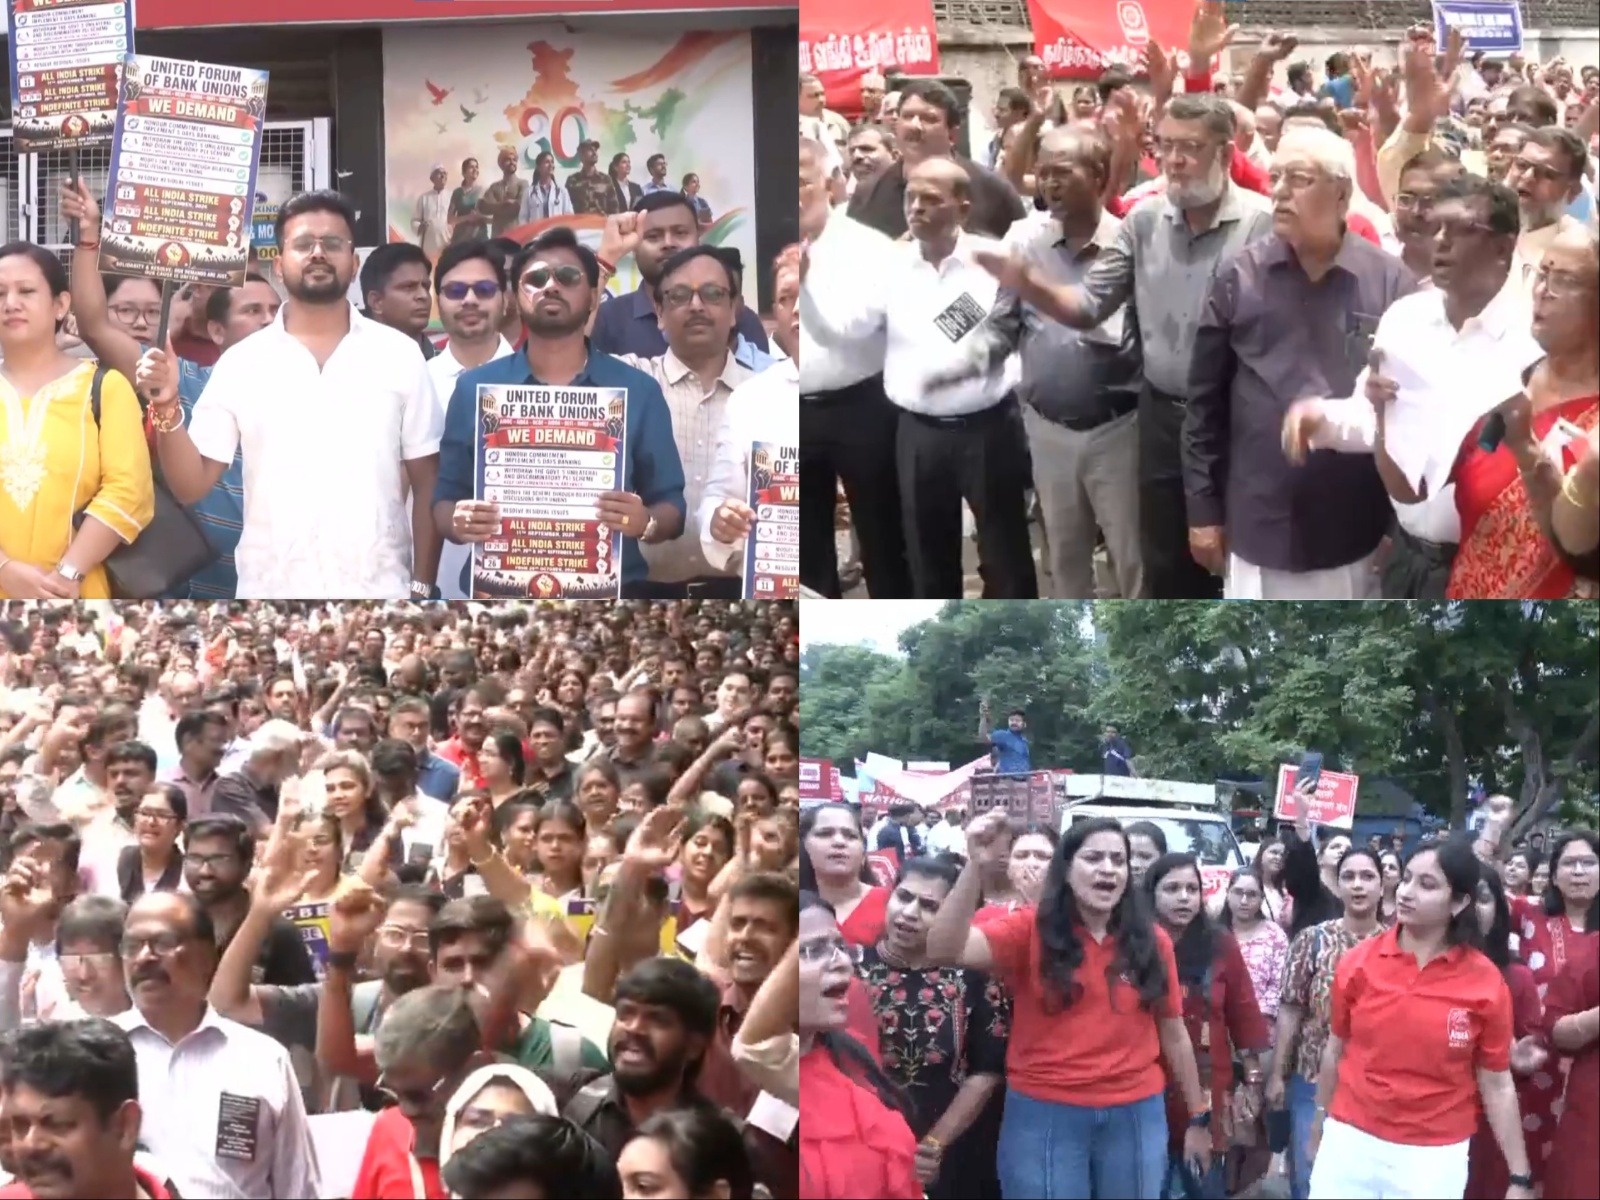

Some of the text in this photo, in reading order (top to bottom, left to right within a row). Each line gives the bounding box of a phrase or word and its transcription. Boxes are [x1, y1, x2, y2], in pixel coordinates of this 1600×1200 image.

[42, 66, 106, 82] ALL INDIA STRIKE
[150, 60, 242, 83] UNITED FORUM
[44, 82, 106, 96] ALL INDIA STRIKE
[144, 73, 159, 86] OF
[163, 76, 198, 92] BANK
[202, 81, 248, 98] UNIONS
[40, 101, 82, 113] INDEFINITE
[84, 98, 110, 108] STRIKE
[148, 98, 237, 122] WE DEMAND
[144, 188, 220, 206] ALL INDIA STRIKE
[144, 206, 158, 216] ALL
[162, 208, 184, 218] INDIA
[188, 210, 218, 222] STRIKE
[137, 222, 220, 240] INDEFINITE STRIKE
[506, 390, 597, 405] UNITED FORUM
[500, 404, 606, 420] OF BANK UNIONS
[507, 429, 596, 446] WE DEMAND
[774, 460, 789, 474] OF
[510, 520, 586, 532] ALL INDIA STRIKE
[512, 538, 586, 550] ALL INDIA STRIKE
[506, 556, 588, 568] INDEFINITE STRIKE
[762, 582, 769, 590] 11
[782, 578, 798, 588] ALL
